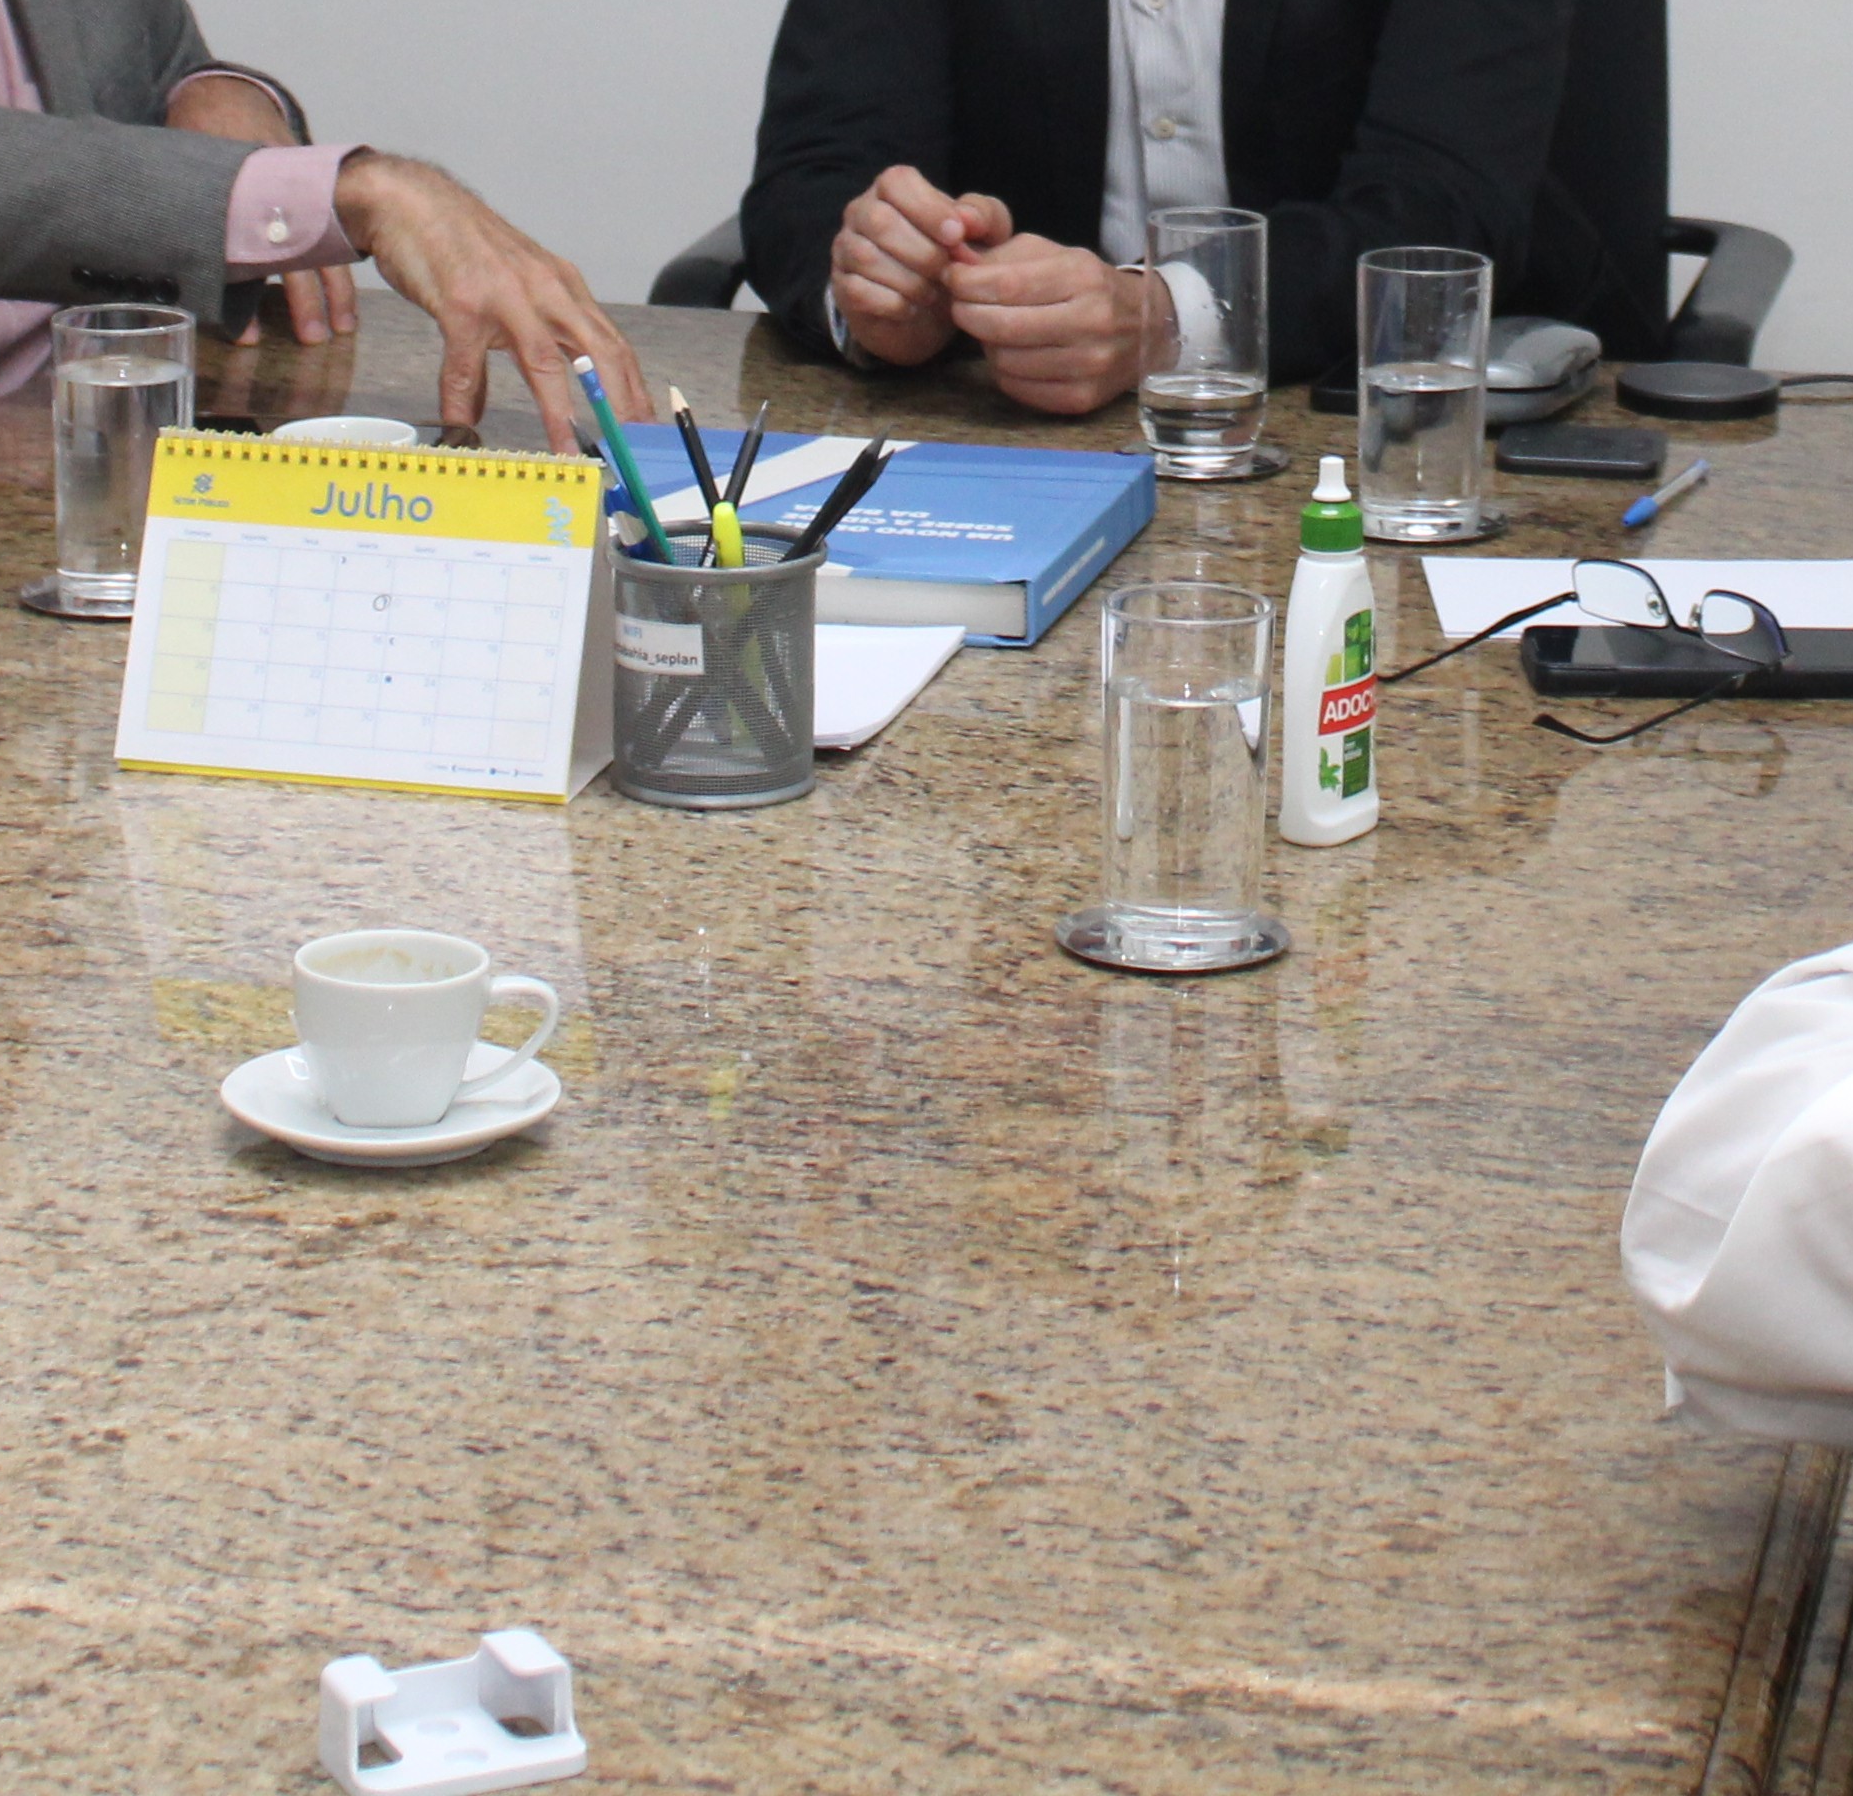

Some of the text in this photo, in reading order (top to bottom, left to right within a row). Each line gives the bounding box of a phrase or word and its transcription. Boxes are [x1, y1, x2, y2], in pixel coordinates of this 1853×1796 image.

[310, 481, 433, 522] Julho
[874, 526, 961, 539] NOVO
[965, 532, 1015, 542] UM
[1323, 689, 1374, 724] ADOC
